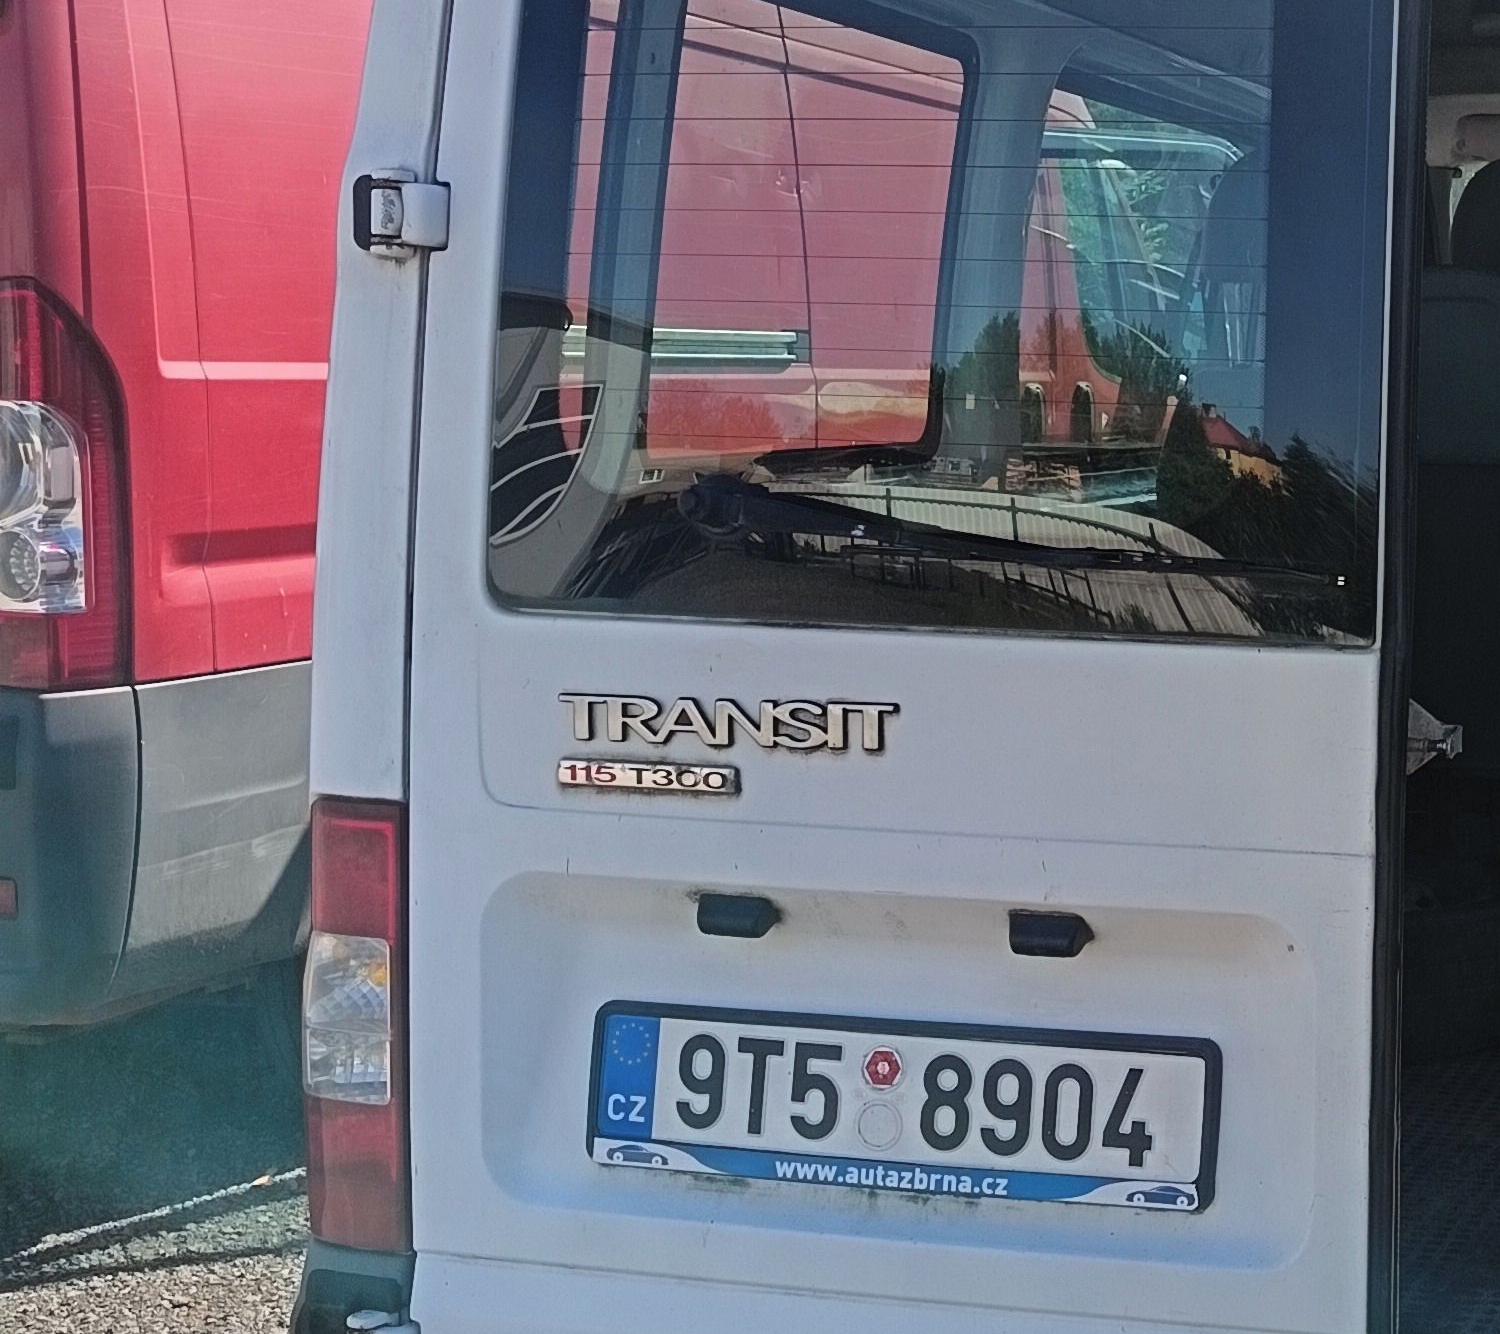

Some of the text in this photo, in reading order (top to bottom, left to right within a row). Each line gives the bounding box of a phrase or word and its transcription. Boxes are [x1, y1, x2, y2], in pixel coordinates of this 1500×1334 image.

[557, 693, 899, 750] TRANSIT
[564, 764, 729, 789] 115 T300
[606, 1093, 646, 1123] CZ
[675, 1033, 1153, 1168] 9T5 8904
[775, 1160, 1009, 1196] www.autazbrna.cz
